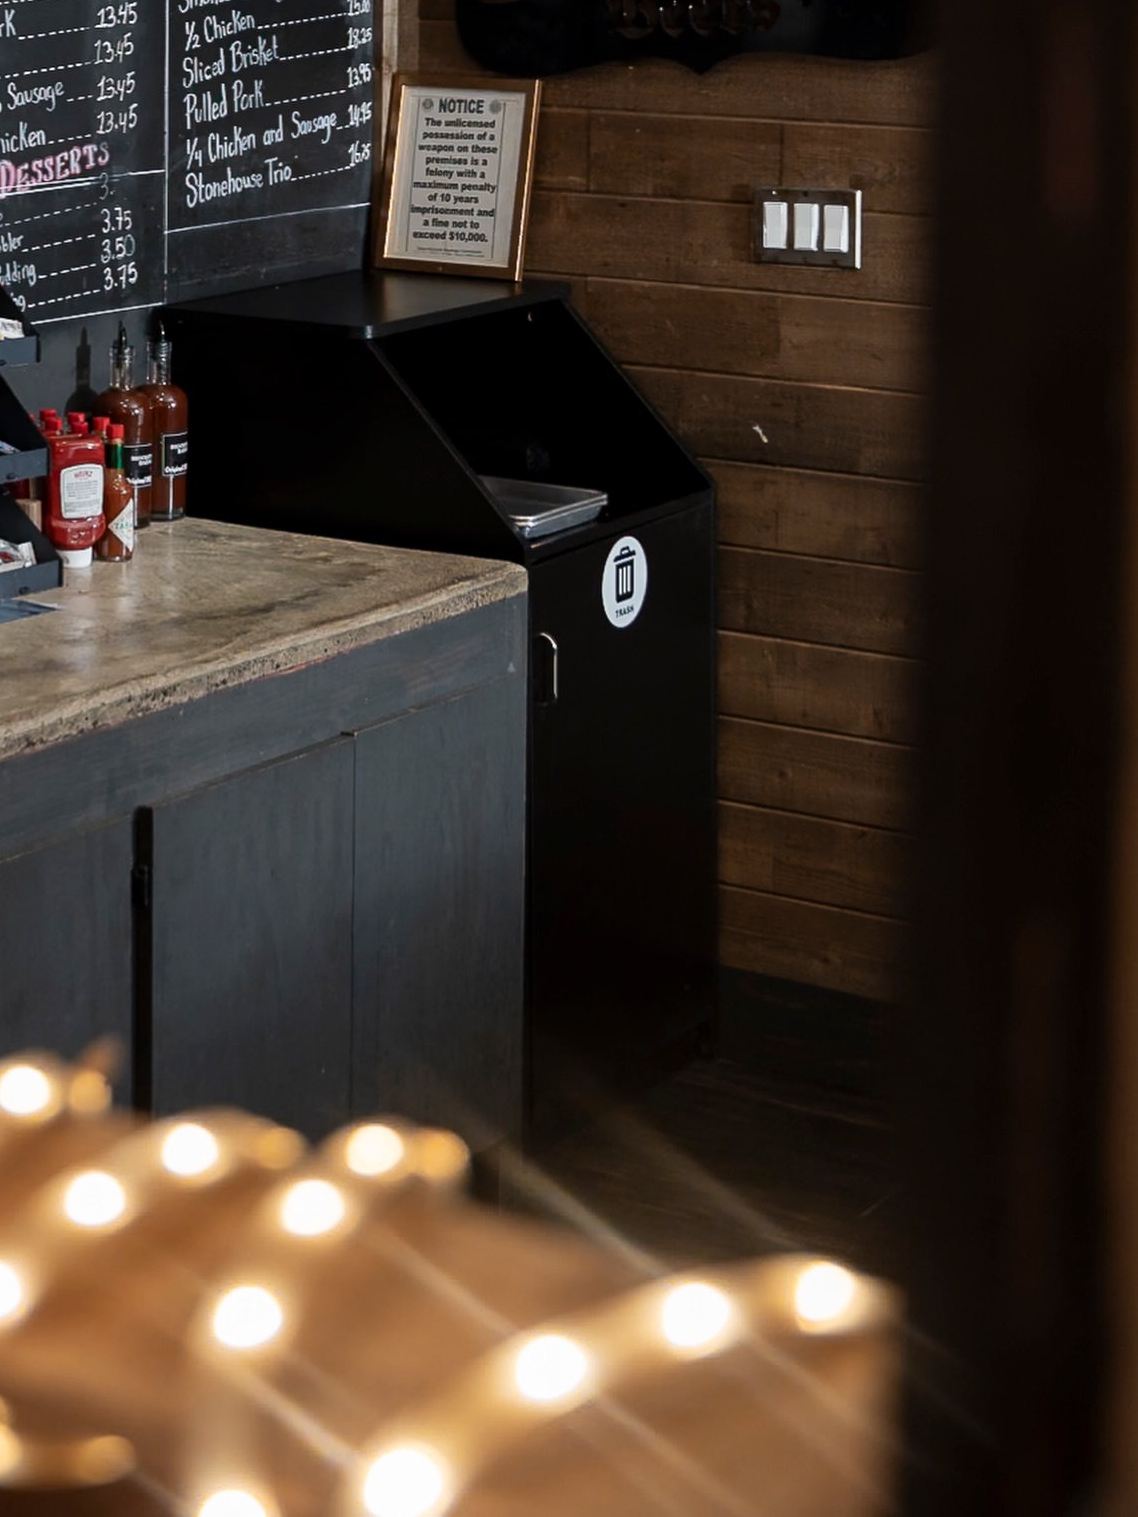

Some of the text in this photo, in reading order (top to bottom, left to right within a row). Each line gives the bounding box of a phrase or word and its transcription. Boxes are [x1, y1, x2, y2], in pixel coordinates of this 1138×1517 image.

[94, 2, 138, 28] 13.45
[203, 10, 256, 43] Chicken
[94, 32, 134, 64] 13.45
[182, 34, 279, 89] Sliced Brisket
[7, 81, 65, 112] Sausage
[96, 71, 136, 102] 13.45
[183, 79, 265, 130] Pulled Pork
[438, 98, 485, 114] NOTICE
[96, 103, 138, 134] 13.45
[424, 117, 496, 129] The unlicensed
[207, 111, 337, 163] Chicken and Sausage
[422, 131, 474, 141] possession
[418, 142, 498, 154] weapon these
[425, 156, 468, 166] premises
[185, 156, 292, 208] Stonehouse Trio
[425, 167, 477, 179] felony with
[412, 180, 496, 193] maximum penalty
[411, 204, 495, 217] imprisonment and
[453, 195, 479, 205] years
[100, 207, 133, 234] 3.75
[431, 217, 449, 227] fine
[412, 231, 488, 243] exceed $10,000.
[100, 234, 136, 264] 3.50
[103, 261, 138, 291] 3.75
[615, 604, 634, 618] TRASH
